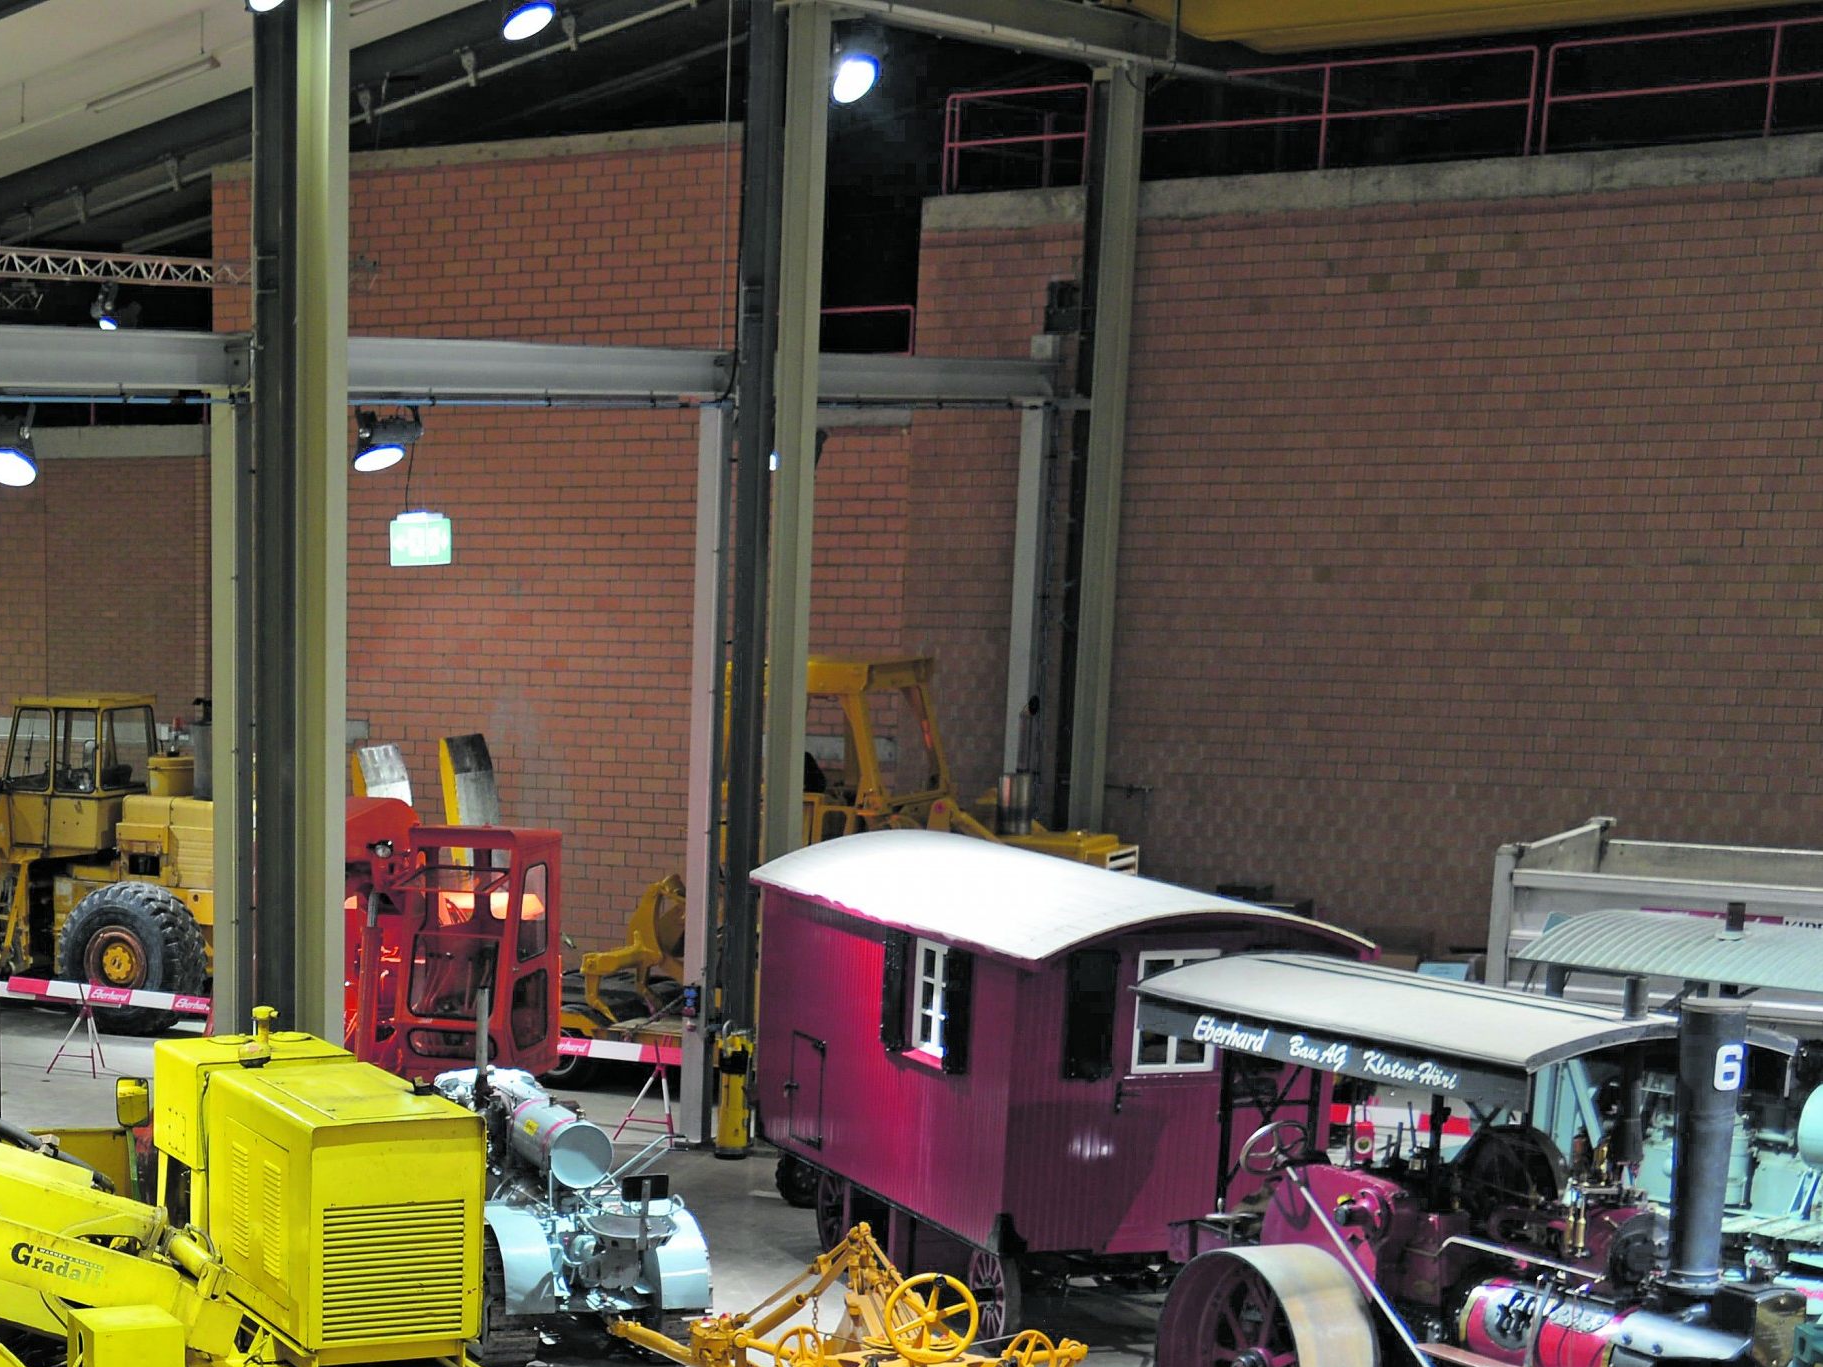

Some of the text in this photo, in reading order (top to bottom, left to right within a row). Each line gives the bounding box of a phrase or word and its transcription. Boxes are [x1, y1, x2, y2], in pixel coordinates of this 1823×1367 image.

[91, 988, 129, 1002] Eberhard
[1192, 1014, 1269, 1053] Eberhard
[1288, 1034, 1320, 1062] Bau
[1320, 1043, 1349, 1072] AG
[1713, 1044, 1744, 1092] 6
[11, 1242, 102, 1285] Gradall
